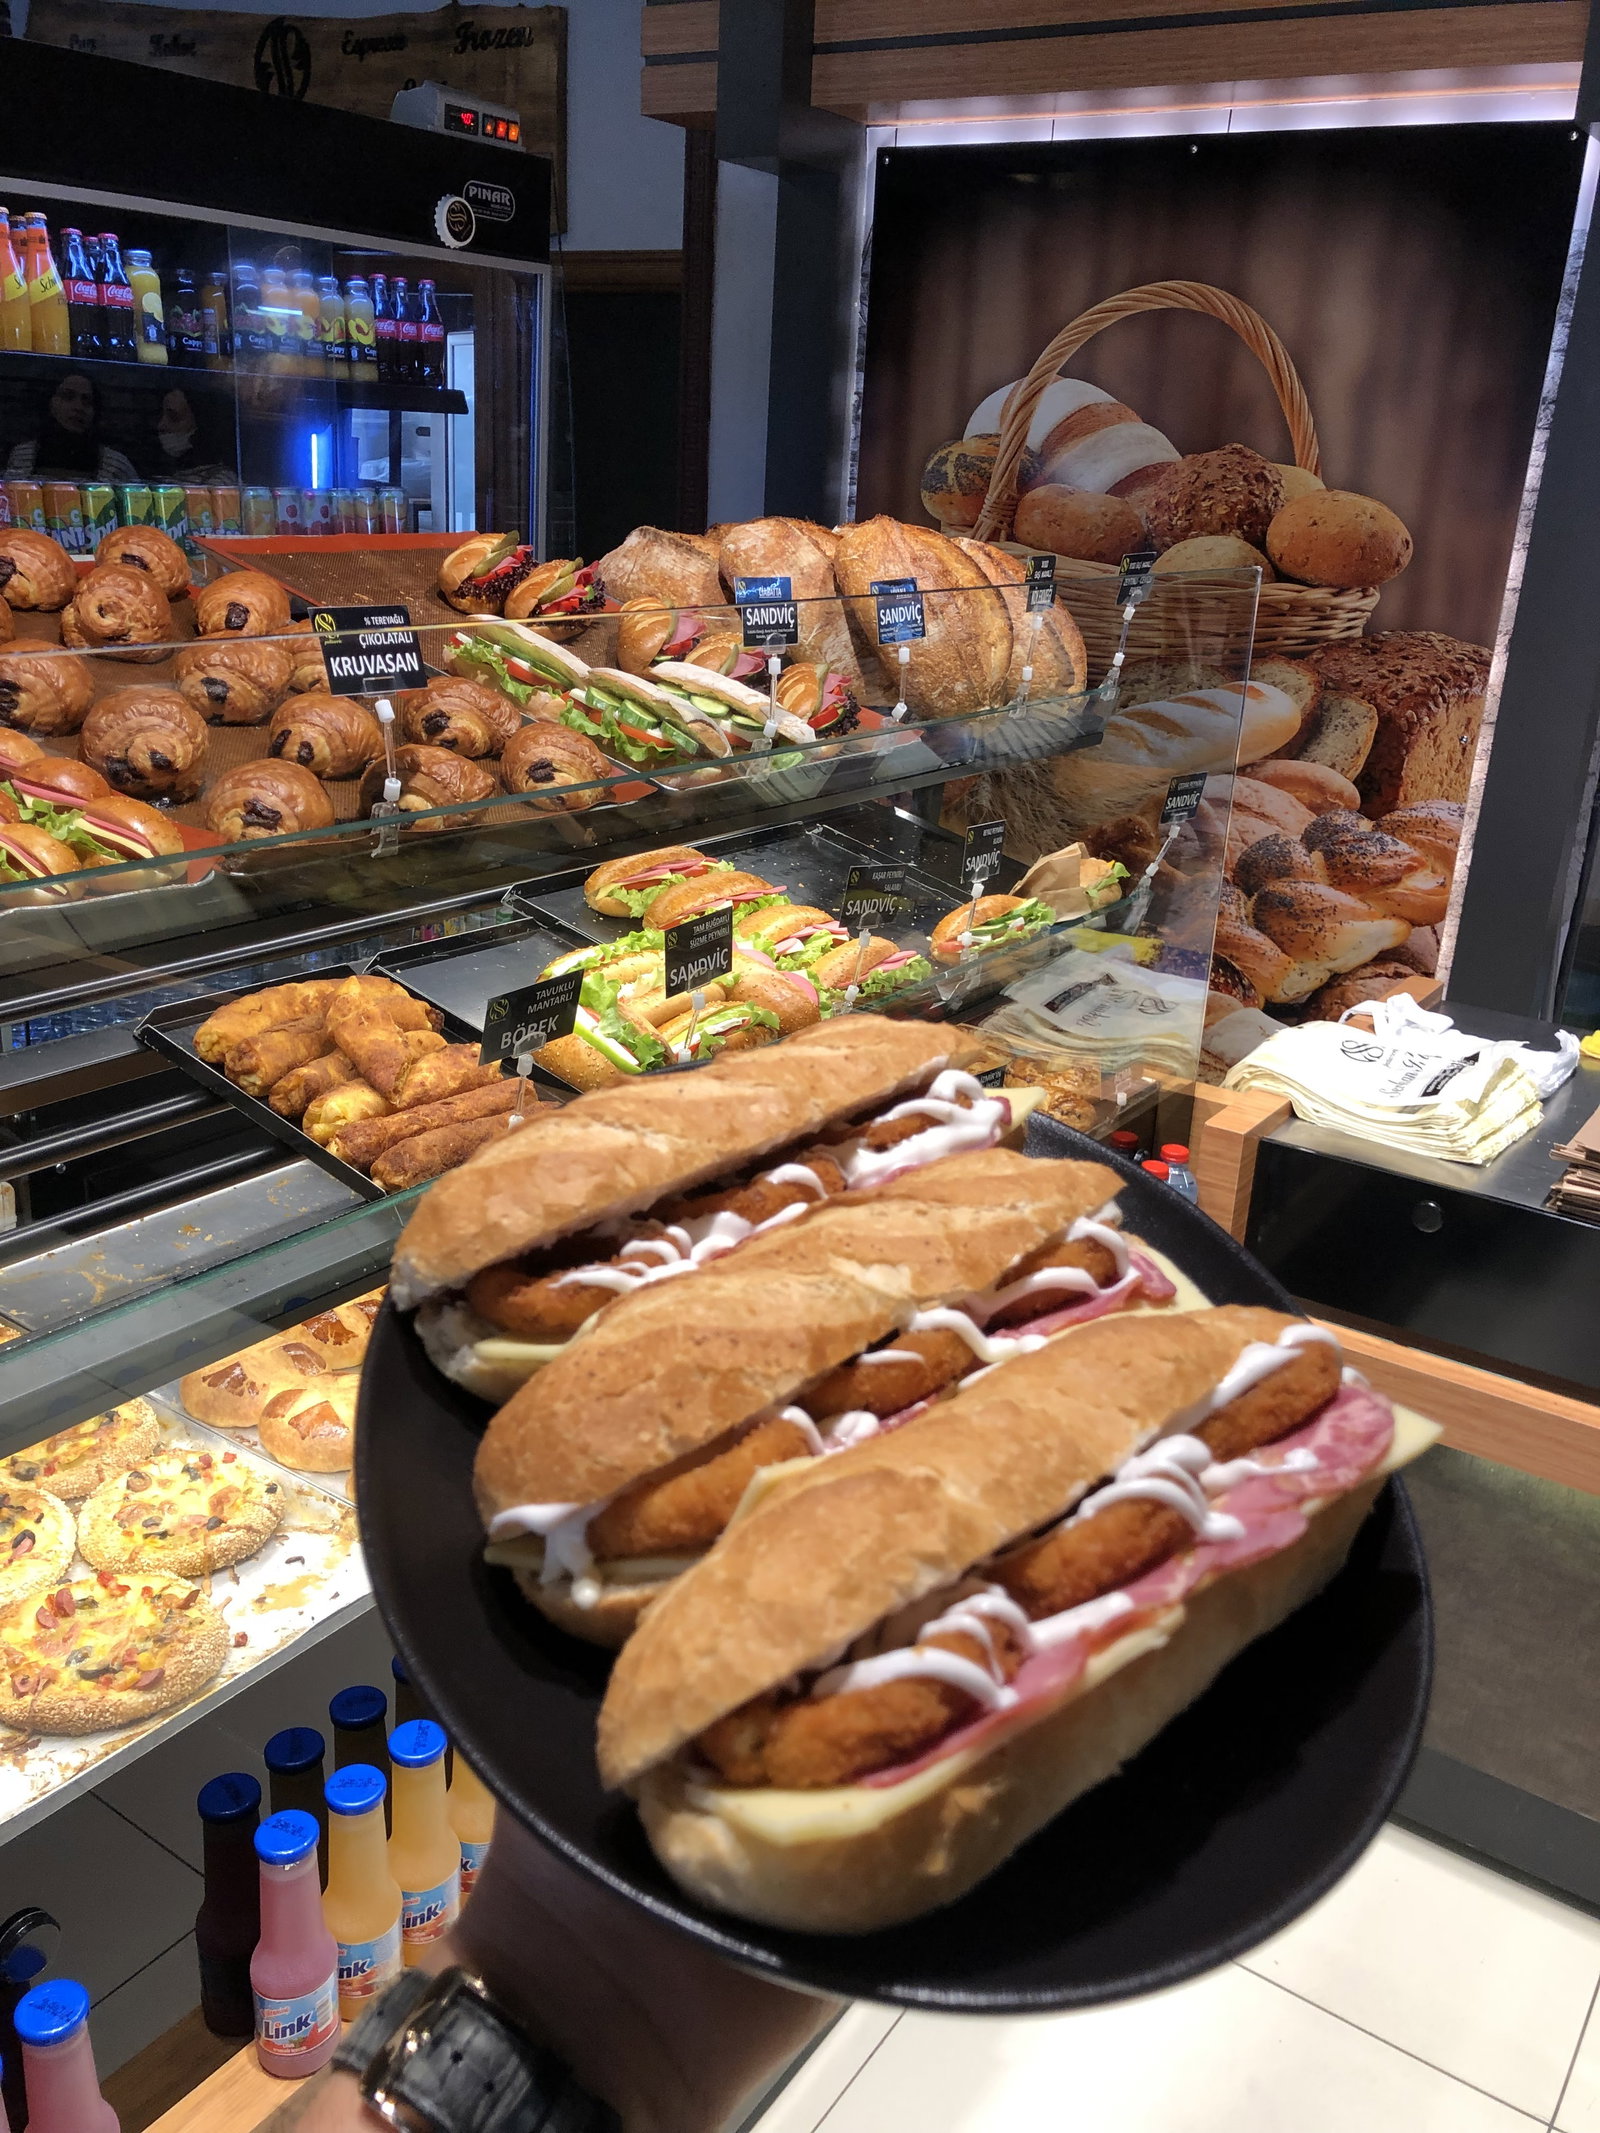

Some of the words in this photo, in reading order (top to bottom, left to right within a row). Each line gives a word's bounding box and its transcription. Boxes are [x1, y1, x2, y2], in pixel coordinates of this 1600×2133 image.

[468, 185, 511, 206] PINAR
[746, 603, 795, 628] SANDVİÇ
[880, 601, 922, 626] SANDVİÇ
[330, 652, 419, 677] KRUVASAN
[965, 848, 1001, 872] SANDVİÇ
[845, 893, 898, 916] SANDVİÇ
[669, 947, 729, 987] SANDVİÇ
[536, 980, 575, 1001] TAVUKLU
[527, 992, 574, 1015] MANTARLI
[500, 1014, 560, 1050] BÖREK
[401, 1901, 441, 1929] ink
[338, 1958, 371, 1979] nk
[263, 2011, 313, 2040] Link
